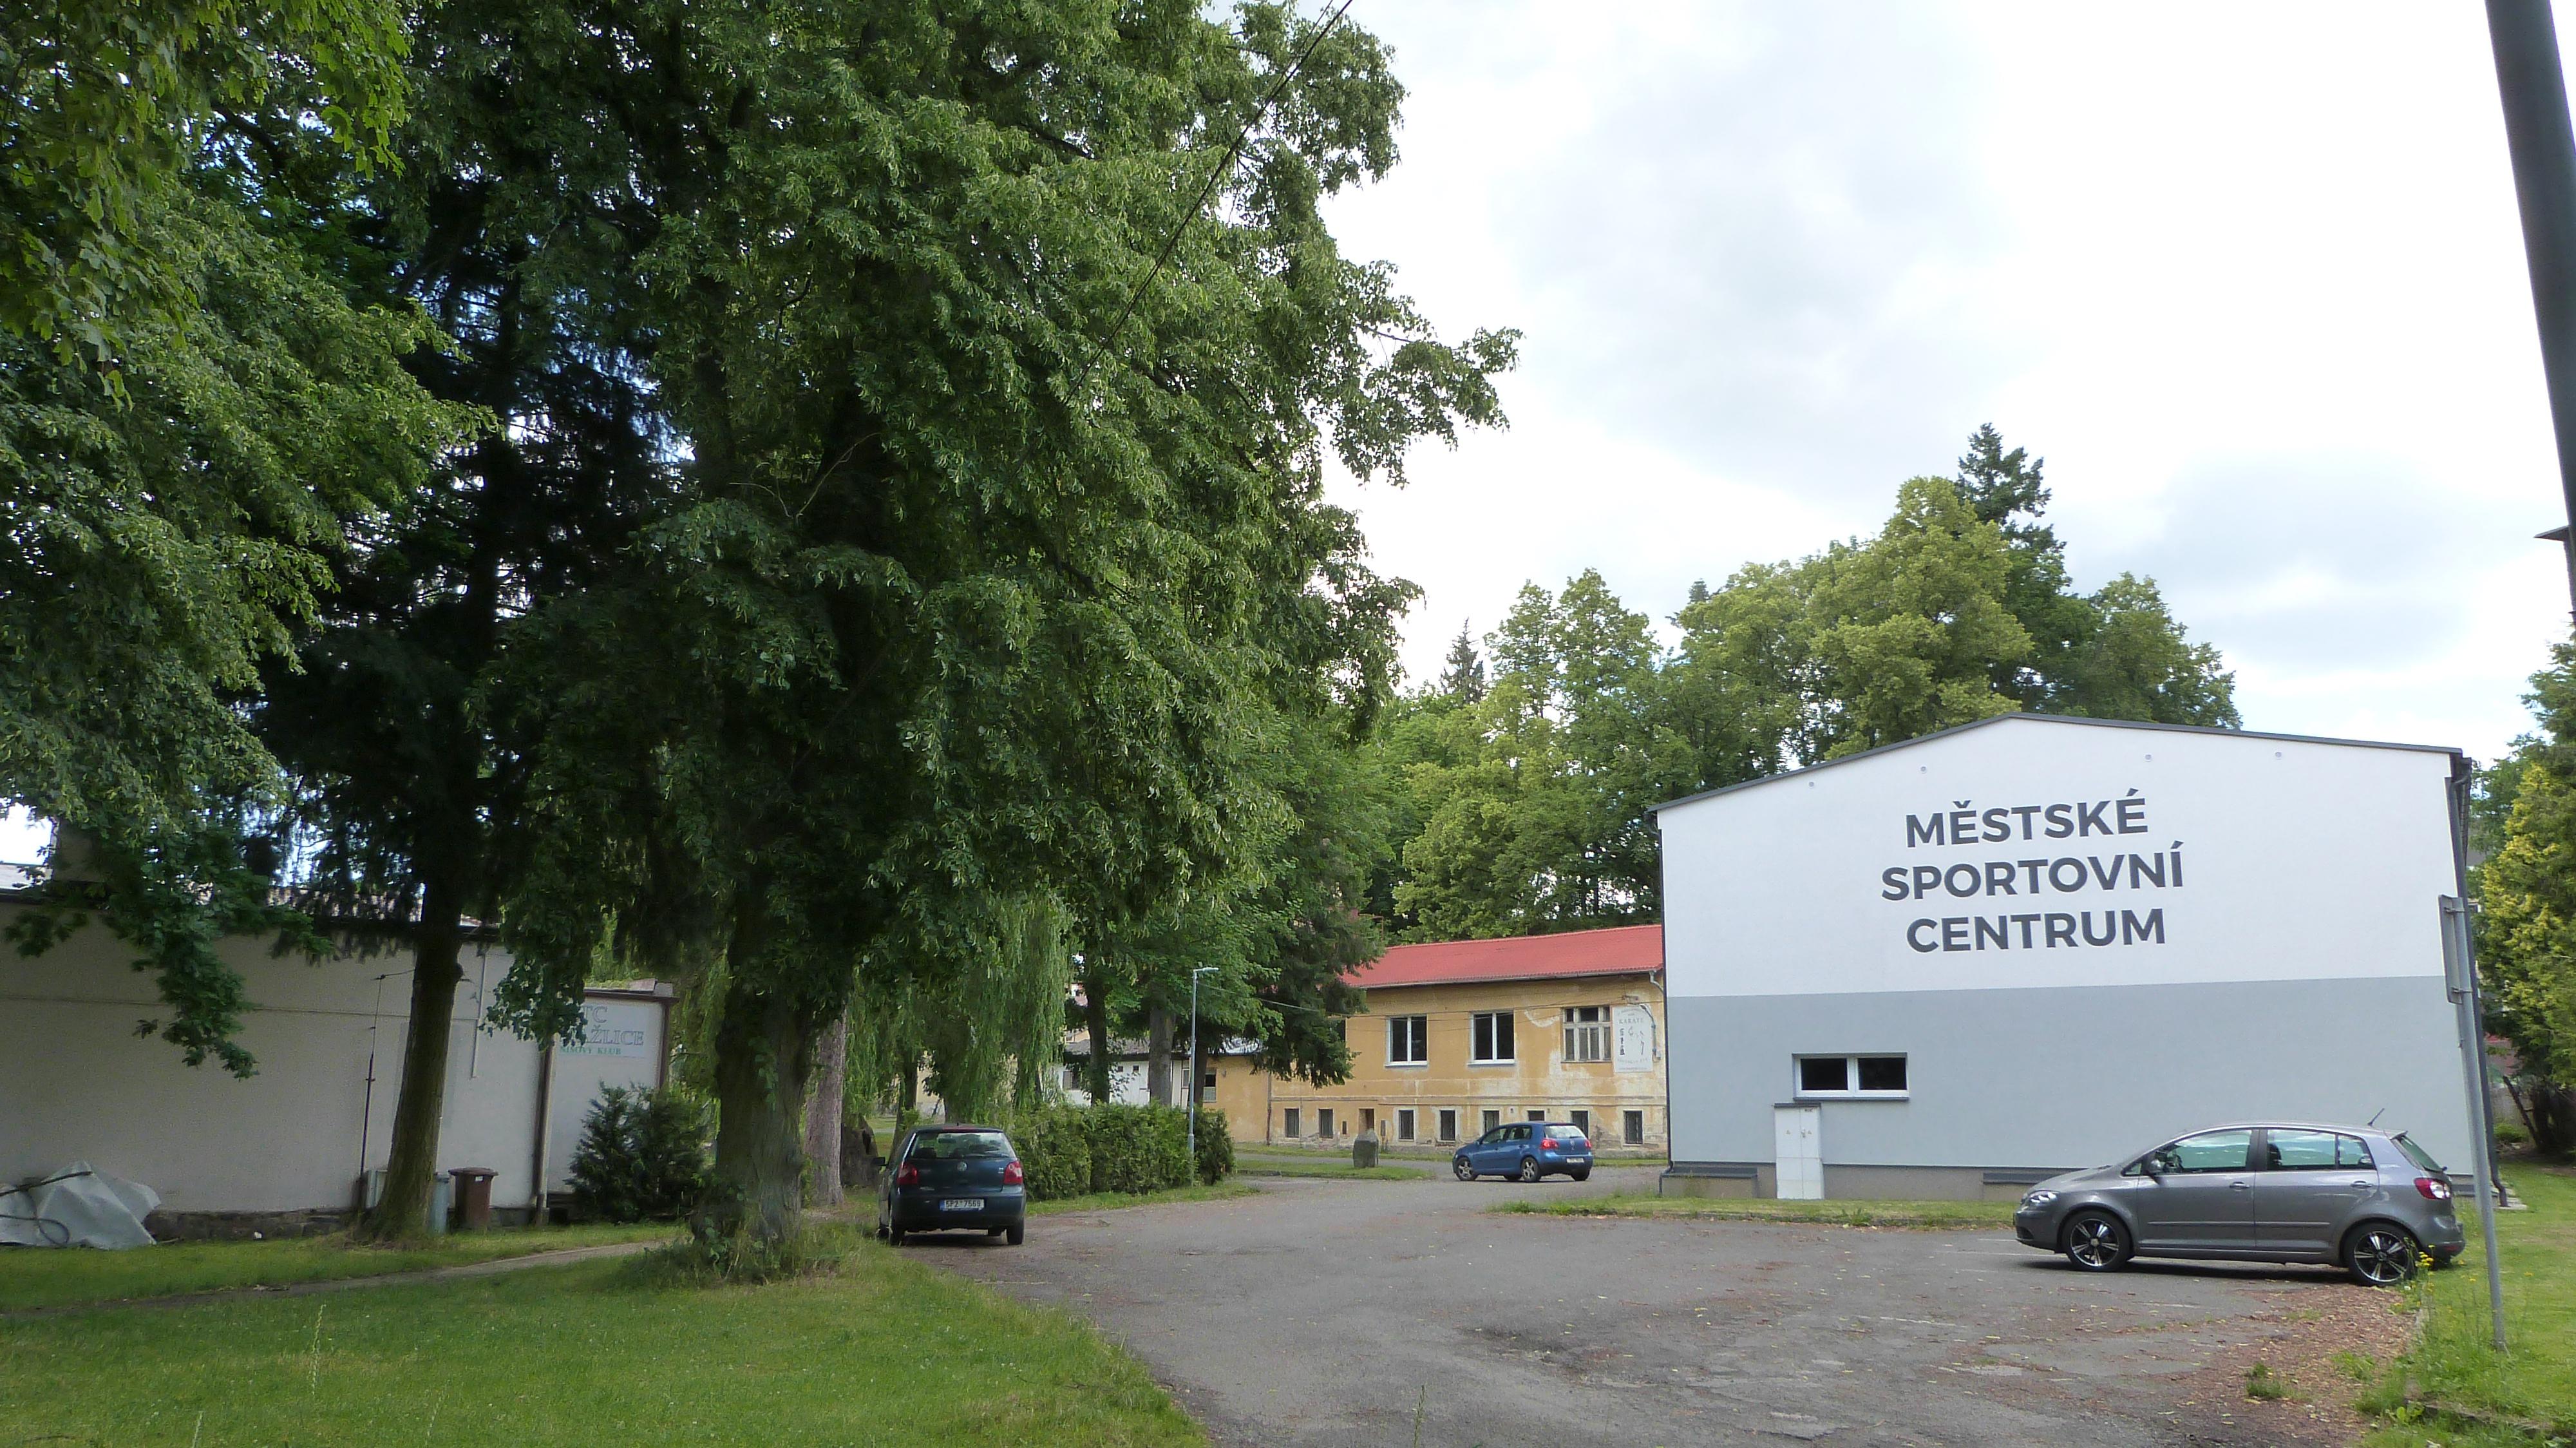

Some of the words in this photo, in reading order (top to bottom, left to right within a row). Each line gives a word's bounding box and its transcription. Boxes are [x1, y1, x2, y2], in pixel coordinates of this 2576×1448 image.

[1906, 788, 2148, 848] MĚSTSKÉ
[1881, 840, 2184, 901] SPORTOVNÍ
[1906, 908, 2165, 953] CENTRUM
